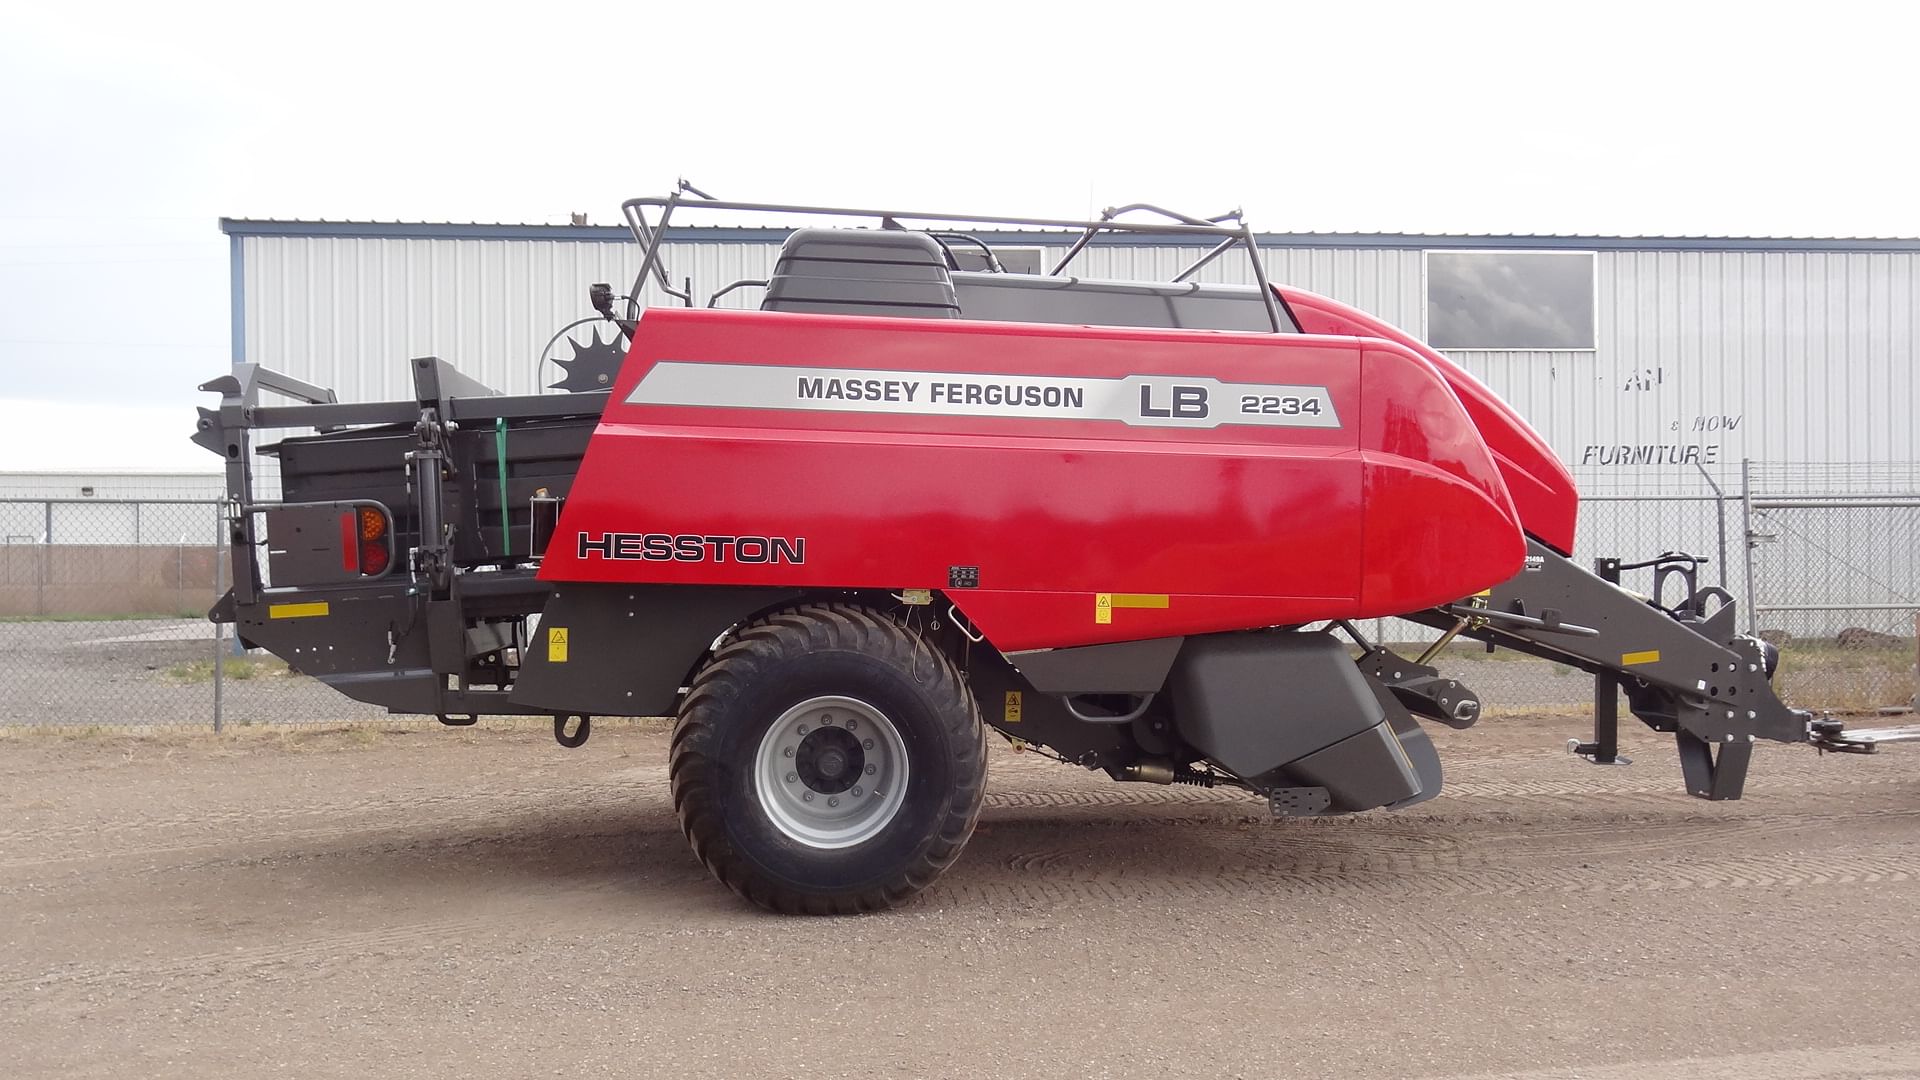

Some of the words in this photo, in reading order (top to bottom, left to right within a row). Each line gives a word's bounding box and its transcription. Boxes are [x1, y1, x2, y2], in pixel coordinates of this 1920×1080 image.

[798, 377, 919, 402] MASSEY
[930, 382, 1083, 408] FERGUSON
[1140, 384, 1209, 419] LB
[1240, 395, 1322, 416] 2234
[1692, 416, 1742, 431] NOW
[1582, 445, 1719, 465] FURNITURE
[577, 531, 806, 565] HESSTON
